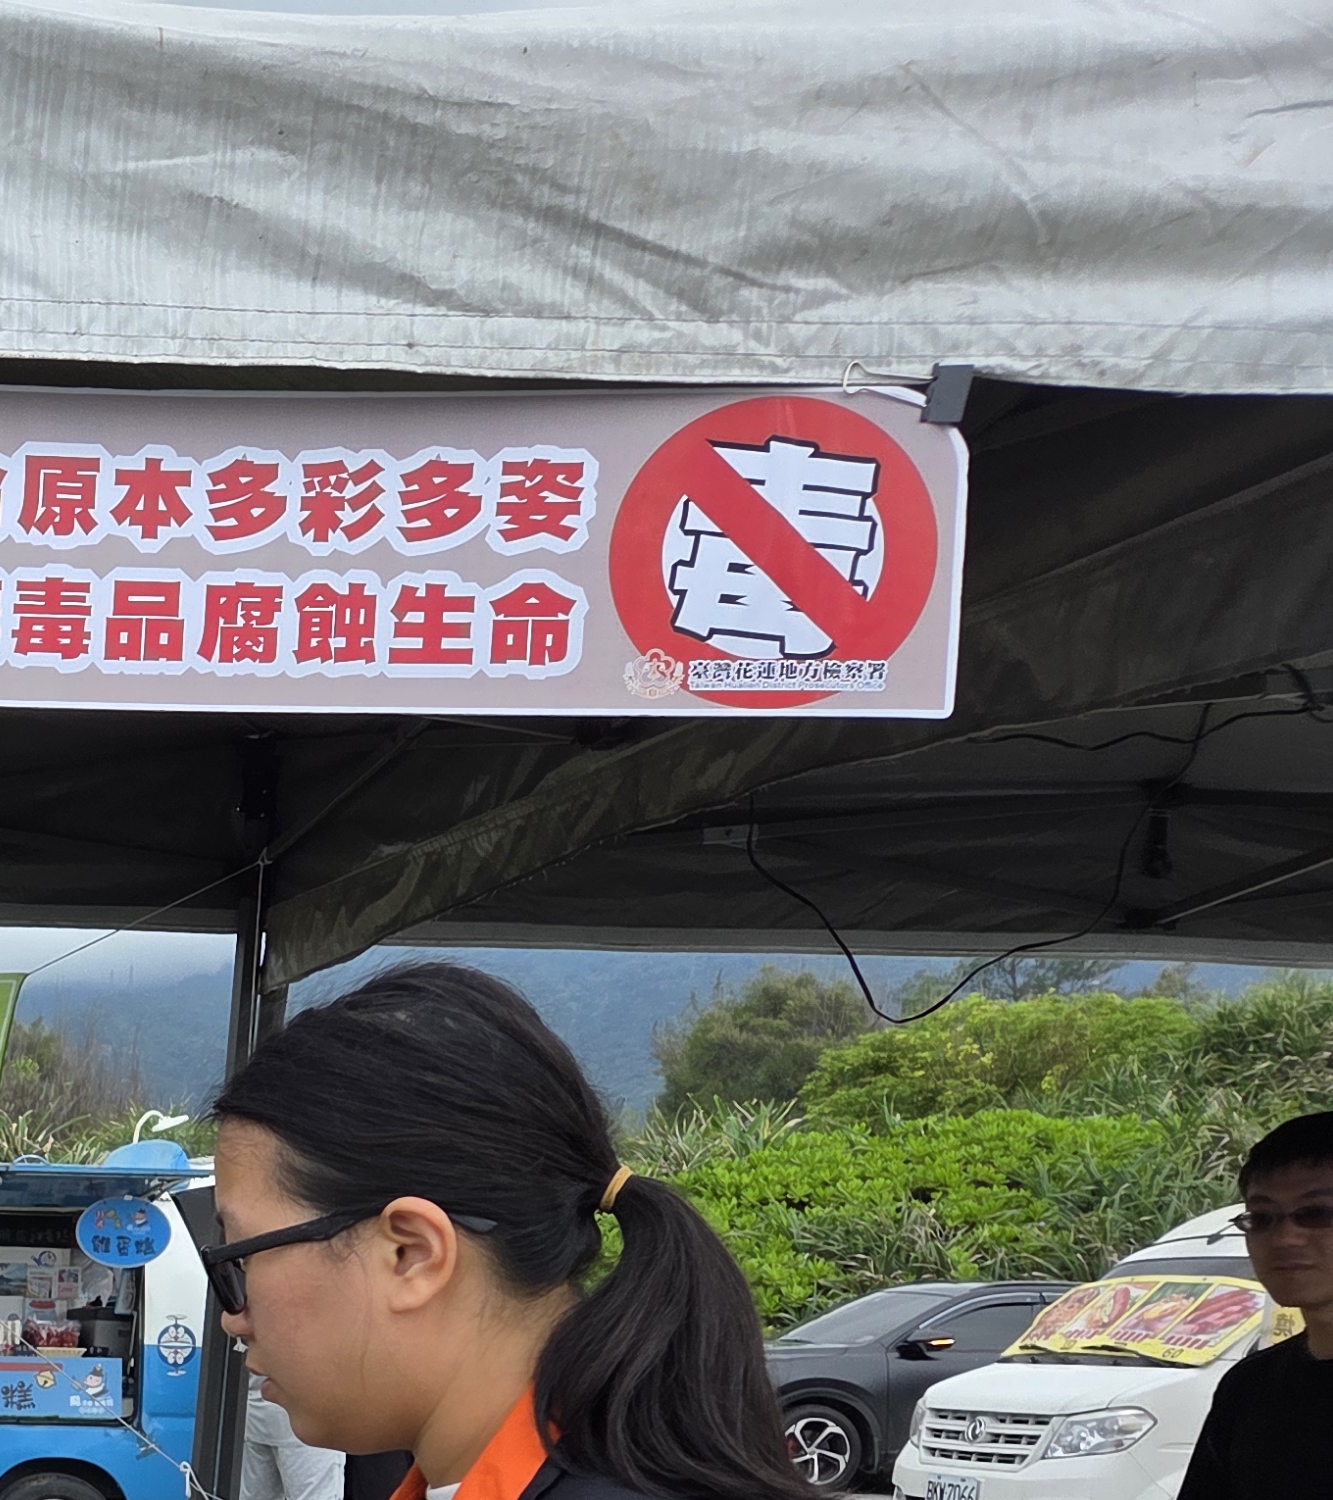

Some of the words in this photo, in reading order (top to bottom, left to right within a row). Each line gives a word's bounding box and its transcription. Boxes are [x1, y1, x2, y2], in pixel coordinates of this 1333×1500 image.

[691, 661, 886, 680] 臺灣花蓮地方檢察署
